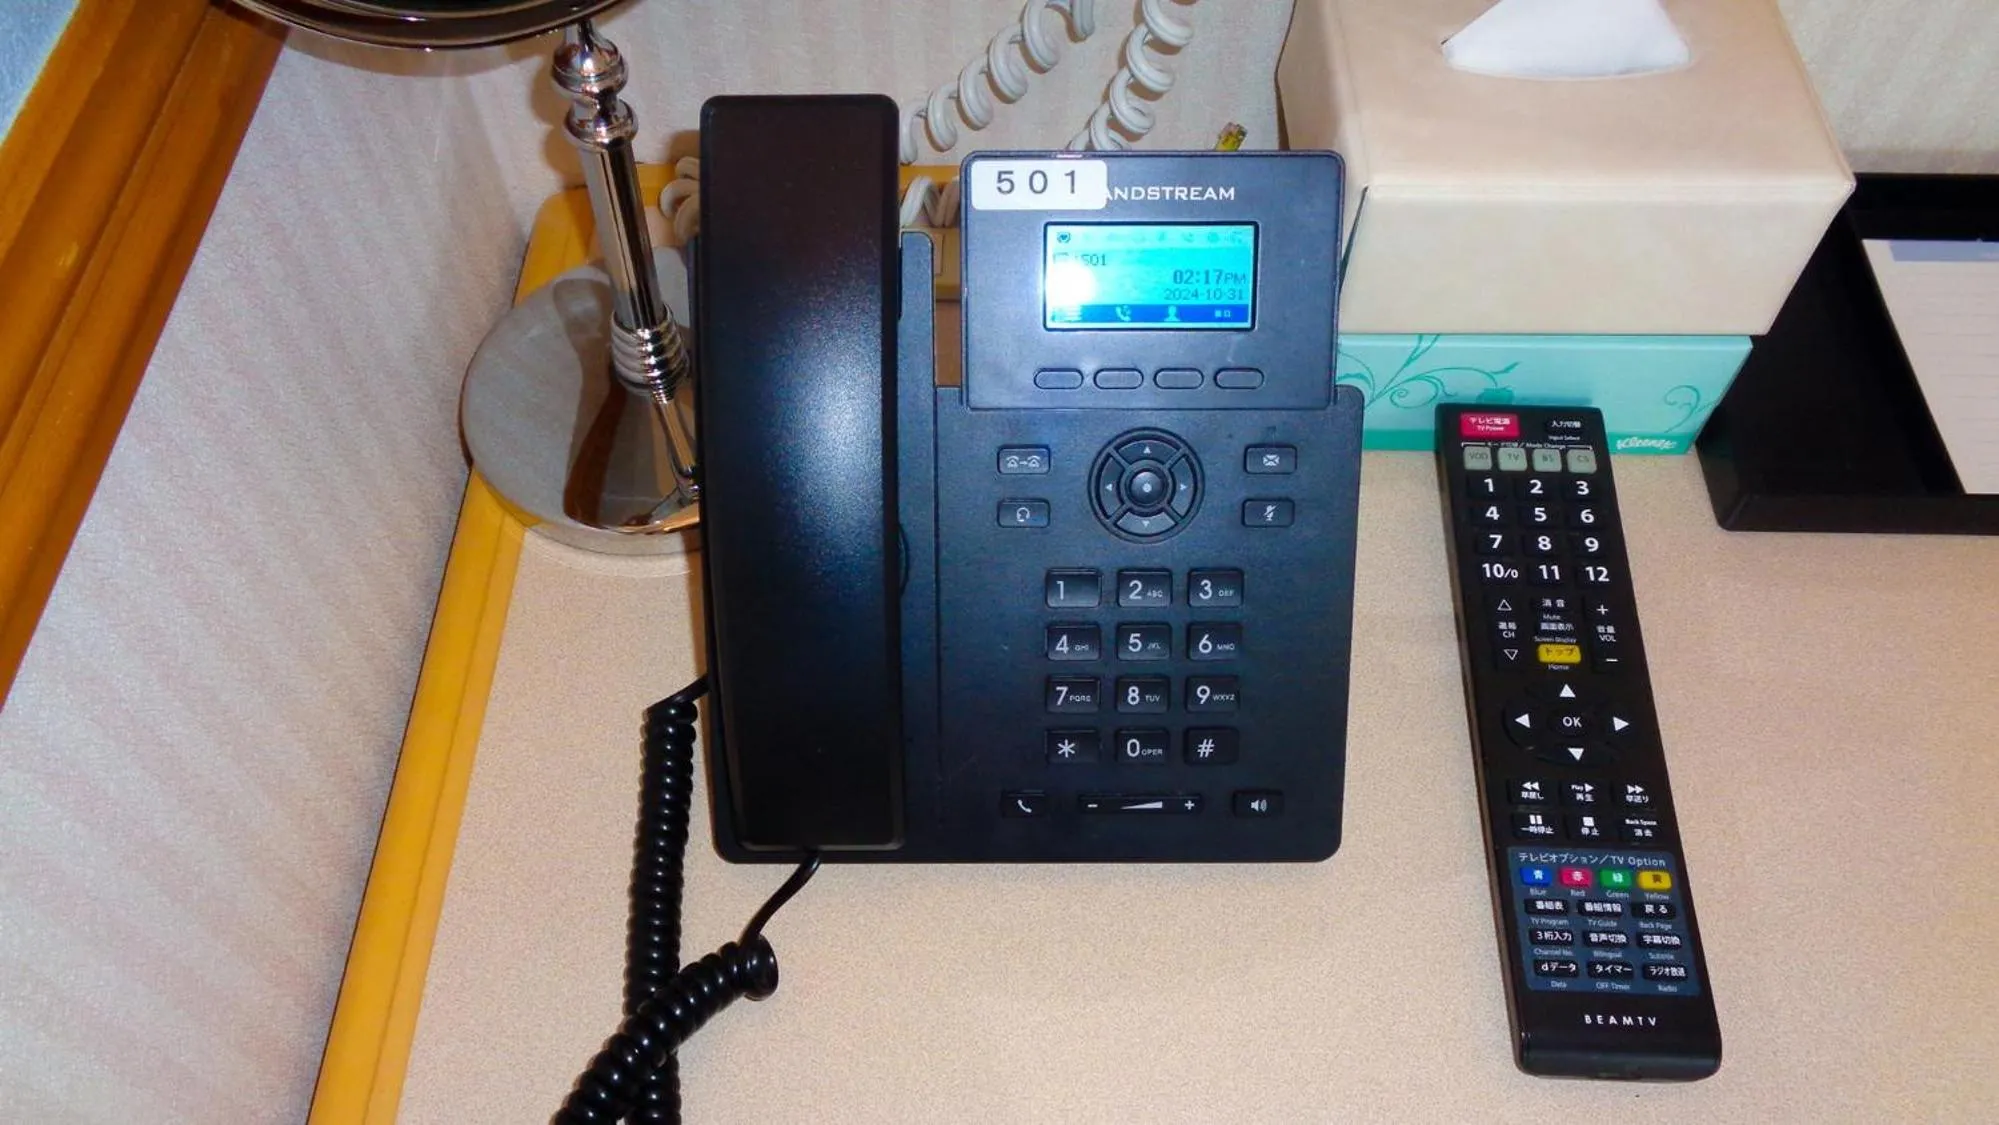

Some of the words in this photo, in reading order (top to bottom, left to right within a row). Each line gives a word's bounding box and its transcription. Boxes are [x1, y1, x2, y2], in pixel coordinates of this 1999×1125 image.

[997, 170, 1077, 194] 501
[1164, 288, 1244, 300] 2024-10-31
[1469, 452, 1489, 460] VOD
[1507, 452, 1520, 461] TV
[1484, 478, 1494, 493] 1
[1529, 479, 1543, 494] 2
[1576, 480, 1589, 495] 3
[1485, 506, 1500, 520] 4
[1534, 507, 1547, 521] 5
[1580, 509, 1595, 523] 6
[1489, 534, 1502, 549] 7
[1537, 535, 1552, 550] 8
[1584, 537, 1599, 552] 9
[1538, 564, 1560, 580] 11
[1585, 566, 1610, 582] 12
[1056, 581, 1064, 600] 1
[1129, 580, 1143, 600] 2
[1147, 590, 1163, 598] ABC
[1199, 579, 1213, 600] 3
[1055, 634, 1069, 654] 4
[1128, 633, 1142, 653] 5
[1199, 634, 1213, 654] 6
[1599, 634, 1616, 642] VOL
[1055, 686, 1068, 706] 7
[1127, 686, 1140, 705] 8
[1196, 685, 1211, 704] 9
[1562, 716, 1582, 728] OK
[1628, 856, 1666, 867] Option
[1530, 888, 1547, 896] Blue
[1570, 889, 1586, 897] Red
[1606, 891, 1629, 899] Green
[1596, 964, 1632, 974] タイマー
